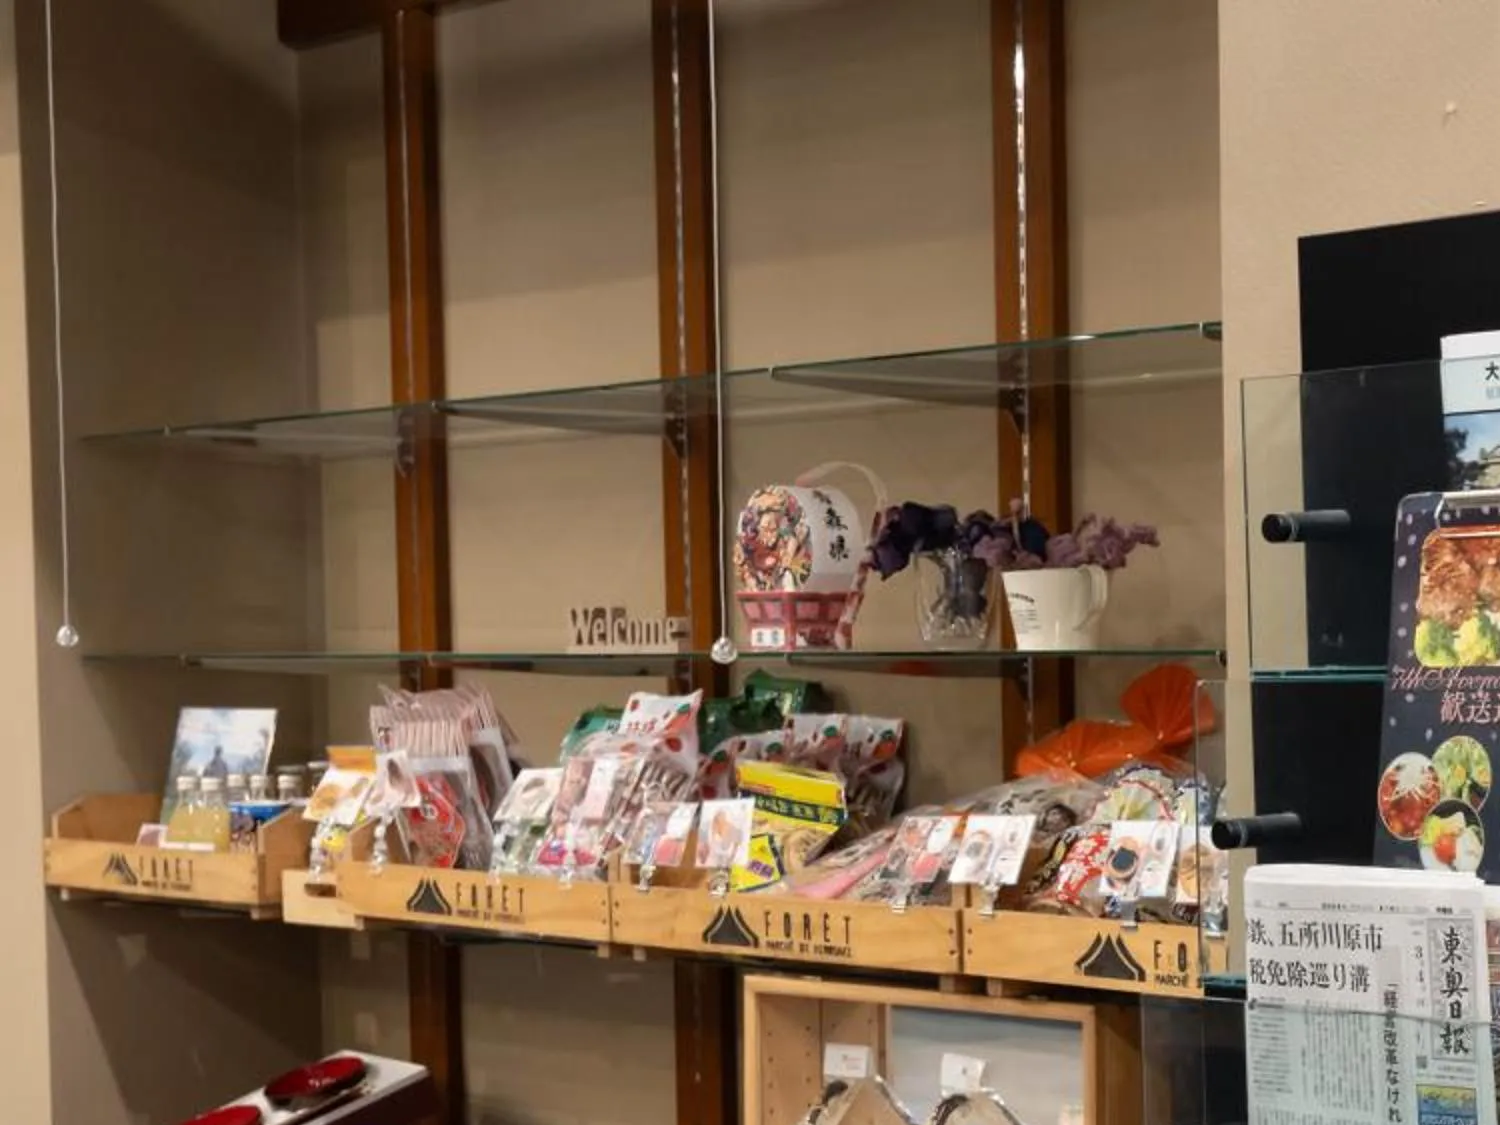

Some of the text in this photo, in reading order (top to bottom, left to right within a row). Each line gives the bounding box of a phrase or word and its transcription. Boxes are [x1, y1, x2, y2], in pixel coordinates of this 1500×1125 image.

[571, 608, 677, 645] Welcome
[1440, 926, 1470, 1055] 東奥日報
